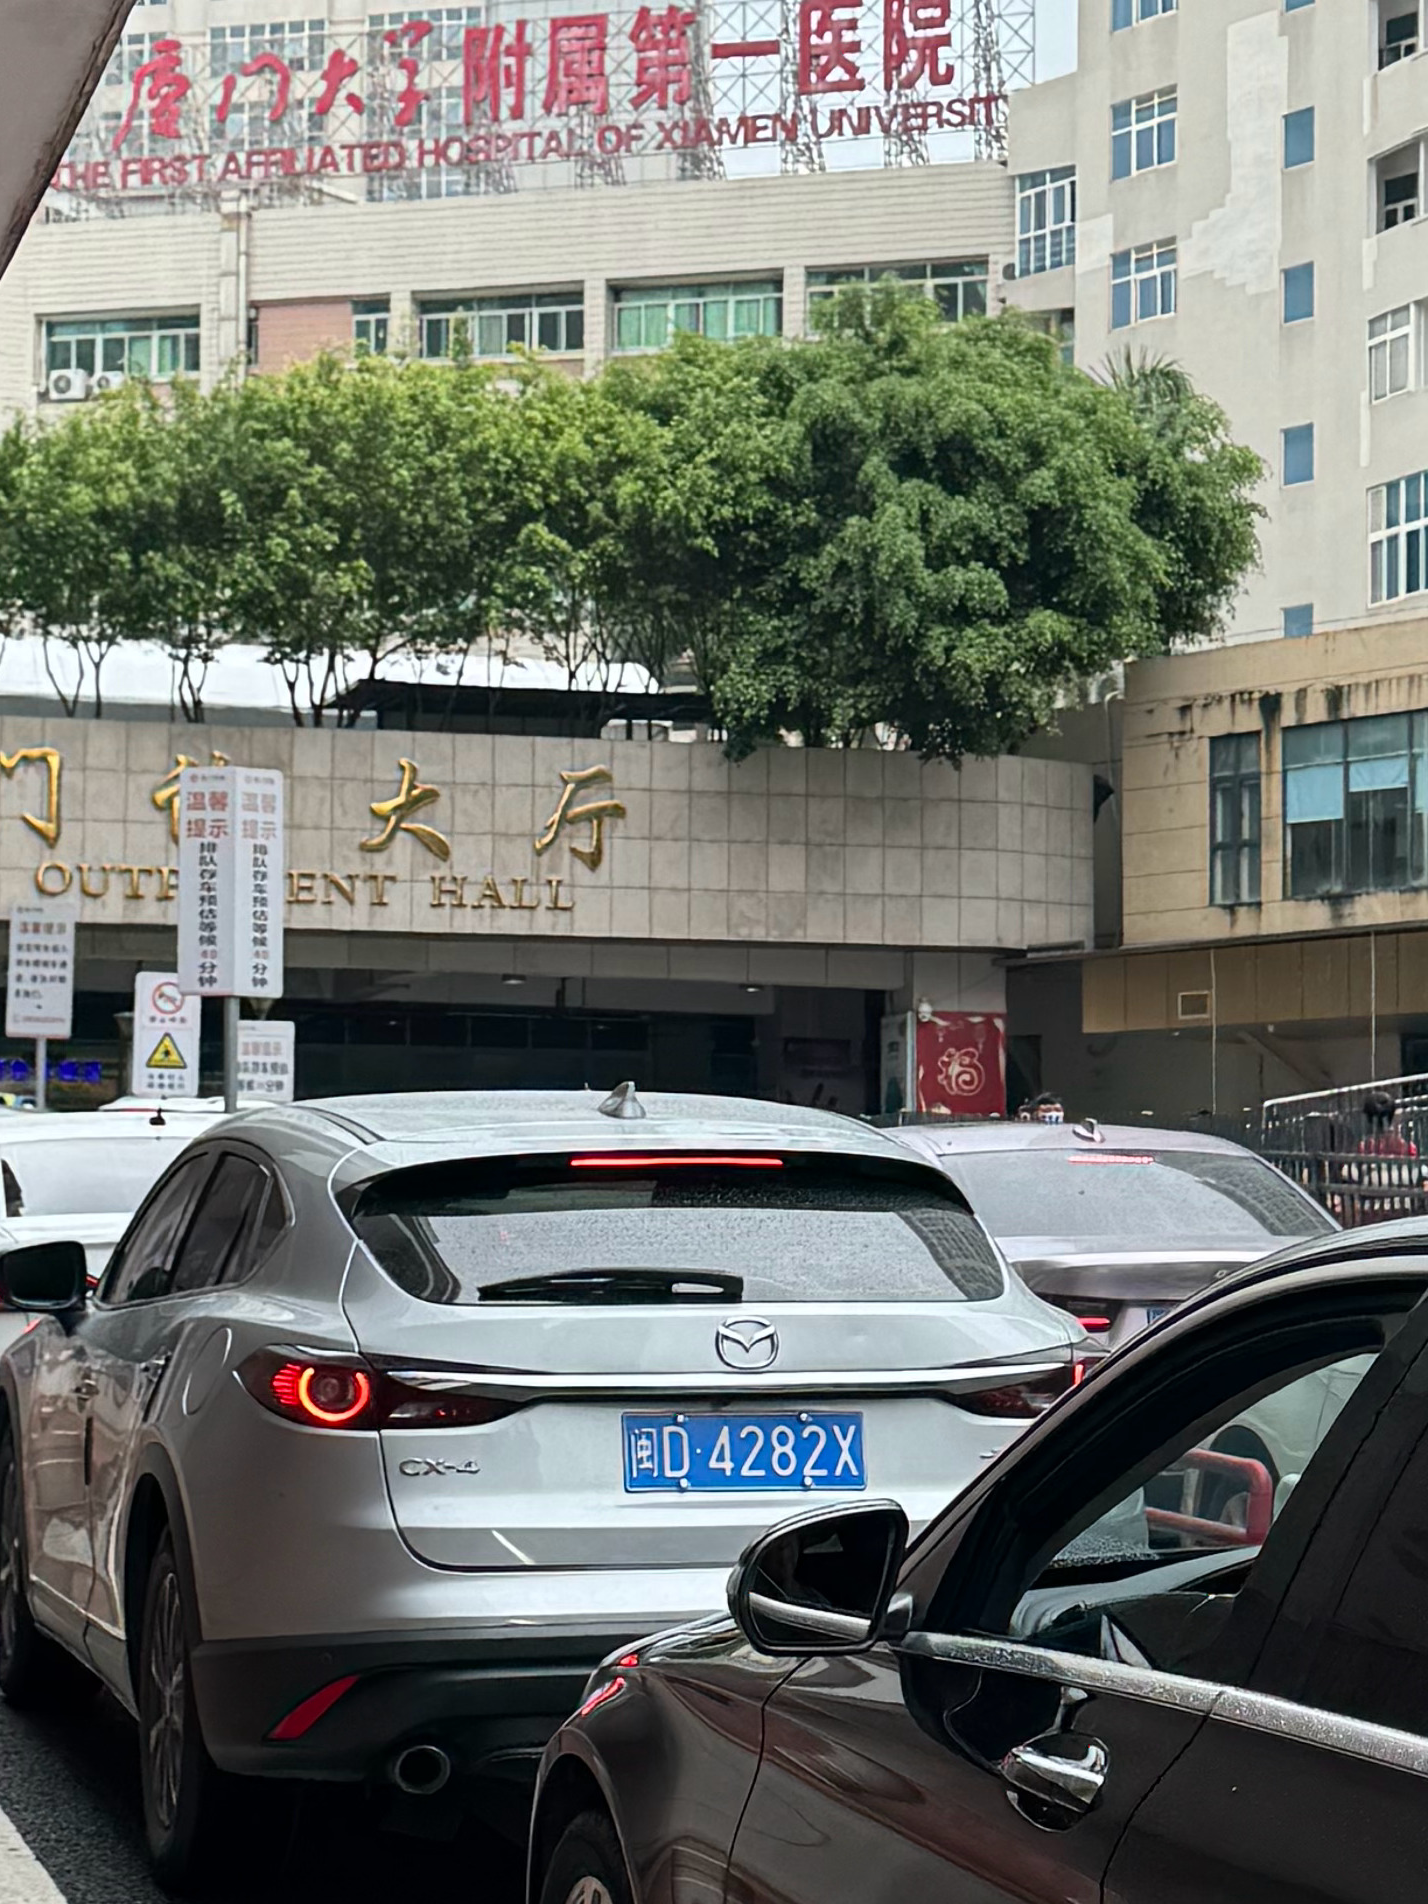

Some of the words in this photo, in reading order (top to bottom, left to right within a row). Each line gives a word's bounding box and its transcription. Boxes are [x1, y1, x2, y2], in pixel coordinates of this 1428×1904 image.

[121, 153, 211, 190] FIRST
[217, 140, 405, 184] AFFILIATED
[417, 127, 581, 169] HOSPITAL
[596, 123, 645, 155] OF
[657, 112, 799, 153] XIAMEN
[810, 94, 1008, 140] UNIVERSIT
[35, 860, 397, 907] OUTPENT
[430, 871, 577, 913] HALL
[399, 1457, 481, 1477] CX-4
